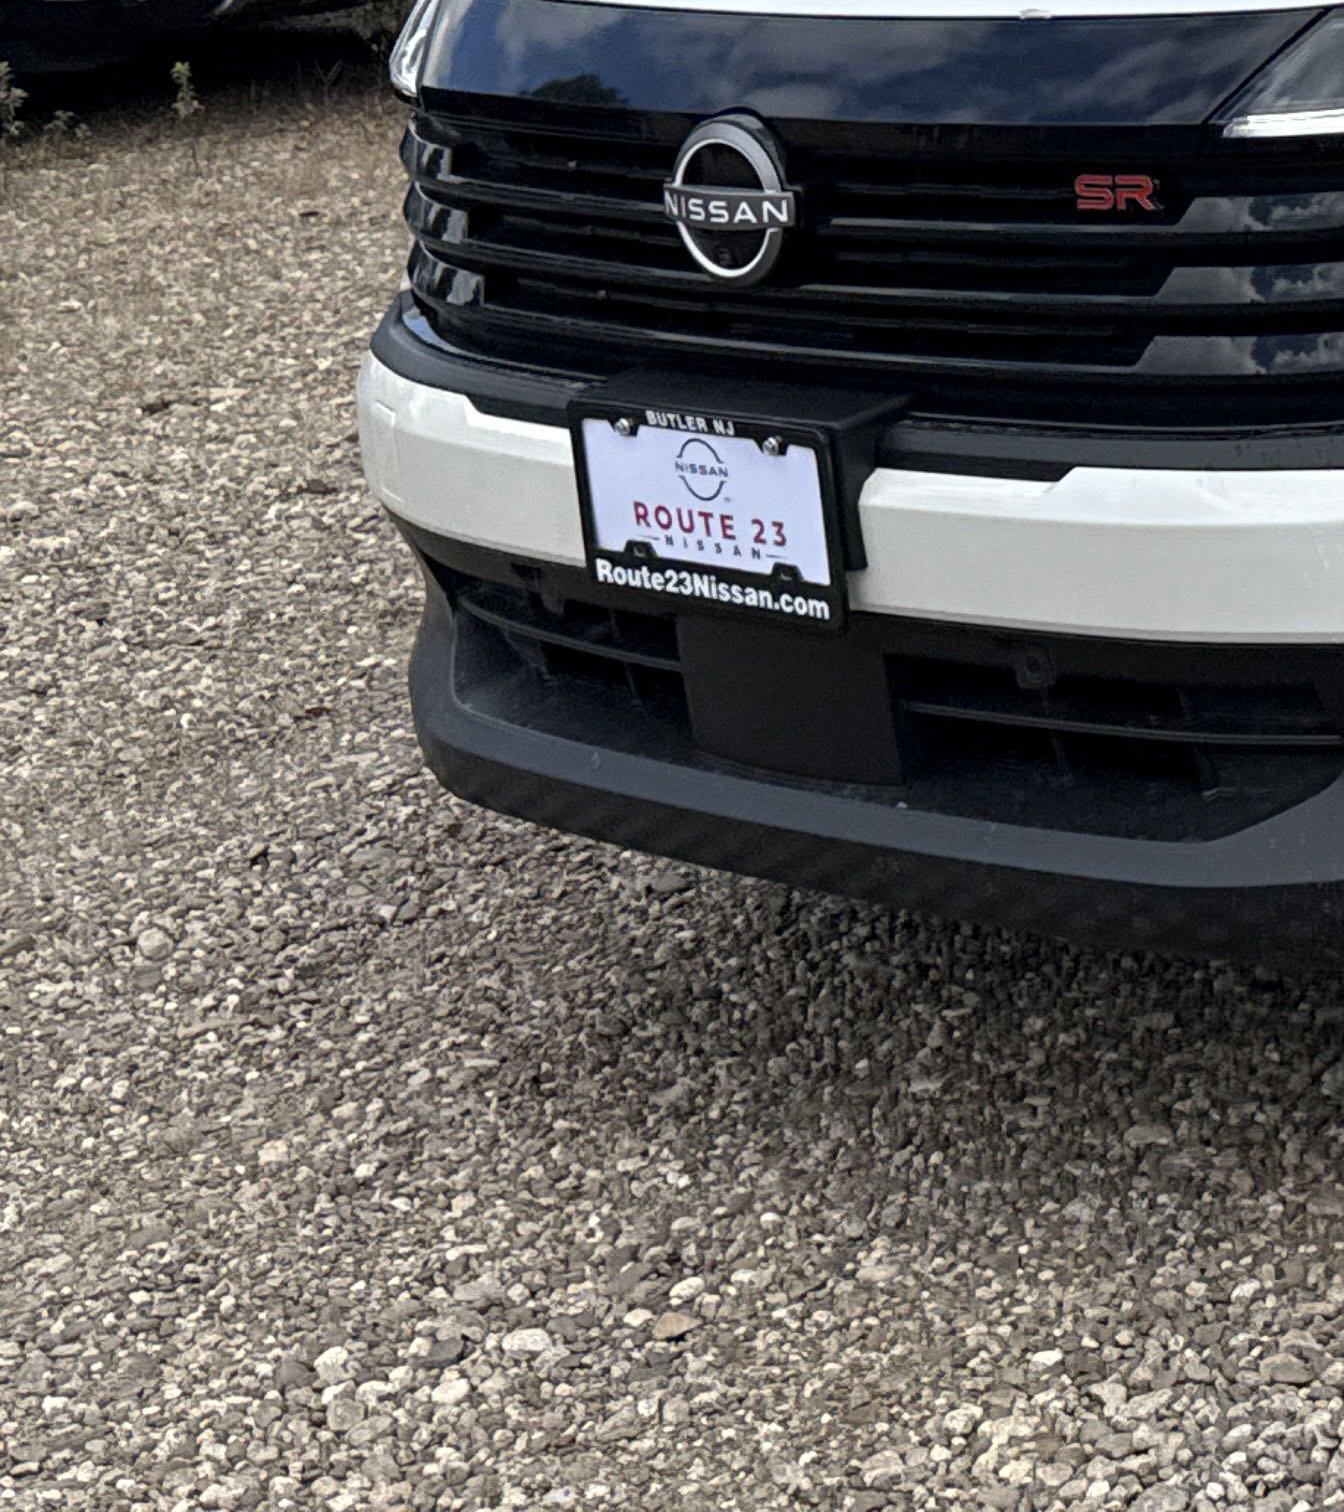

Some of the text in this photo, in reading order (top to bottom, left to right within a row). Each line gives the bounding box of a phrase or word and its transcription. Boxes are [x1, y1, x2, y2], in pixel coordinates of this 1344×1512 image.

[664, 191, 789, 224] NISSAN
[1074, 174, 1155, 211] SR
[645, 410, 735, 436] BUTLER NJ
[674, 461, 728, 478] NISSAN
[632, 501, 788, 547] ROUTE 23
[664, 536, 762, 561] NISSAN
[595, 558, 831, 621] Route23Nissan.com
